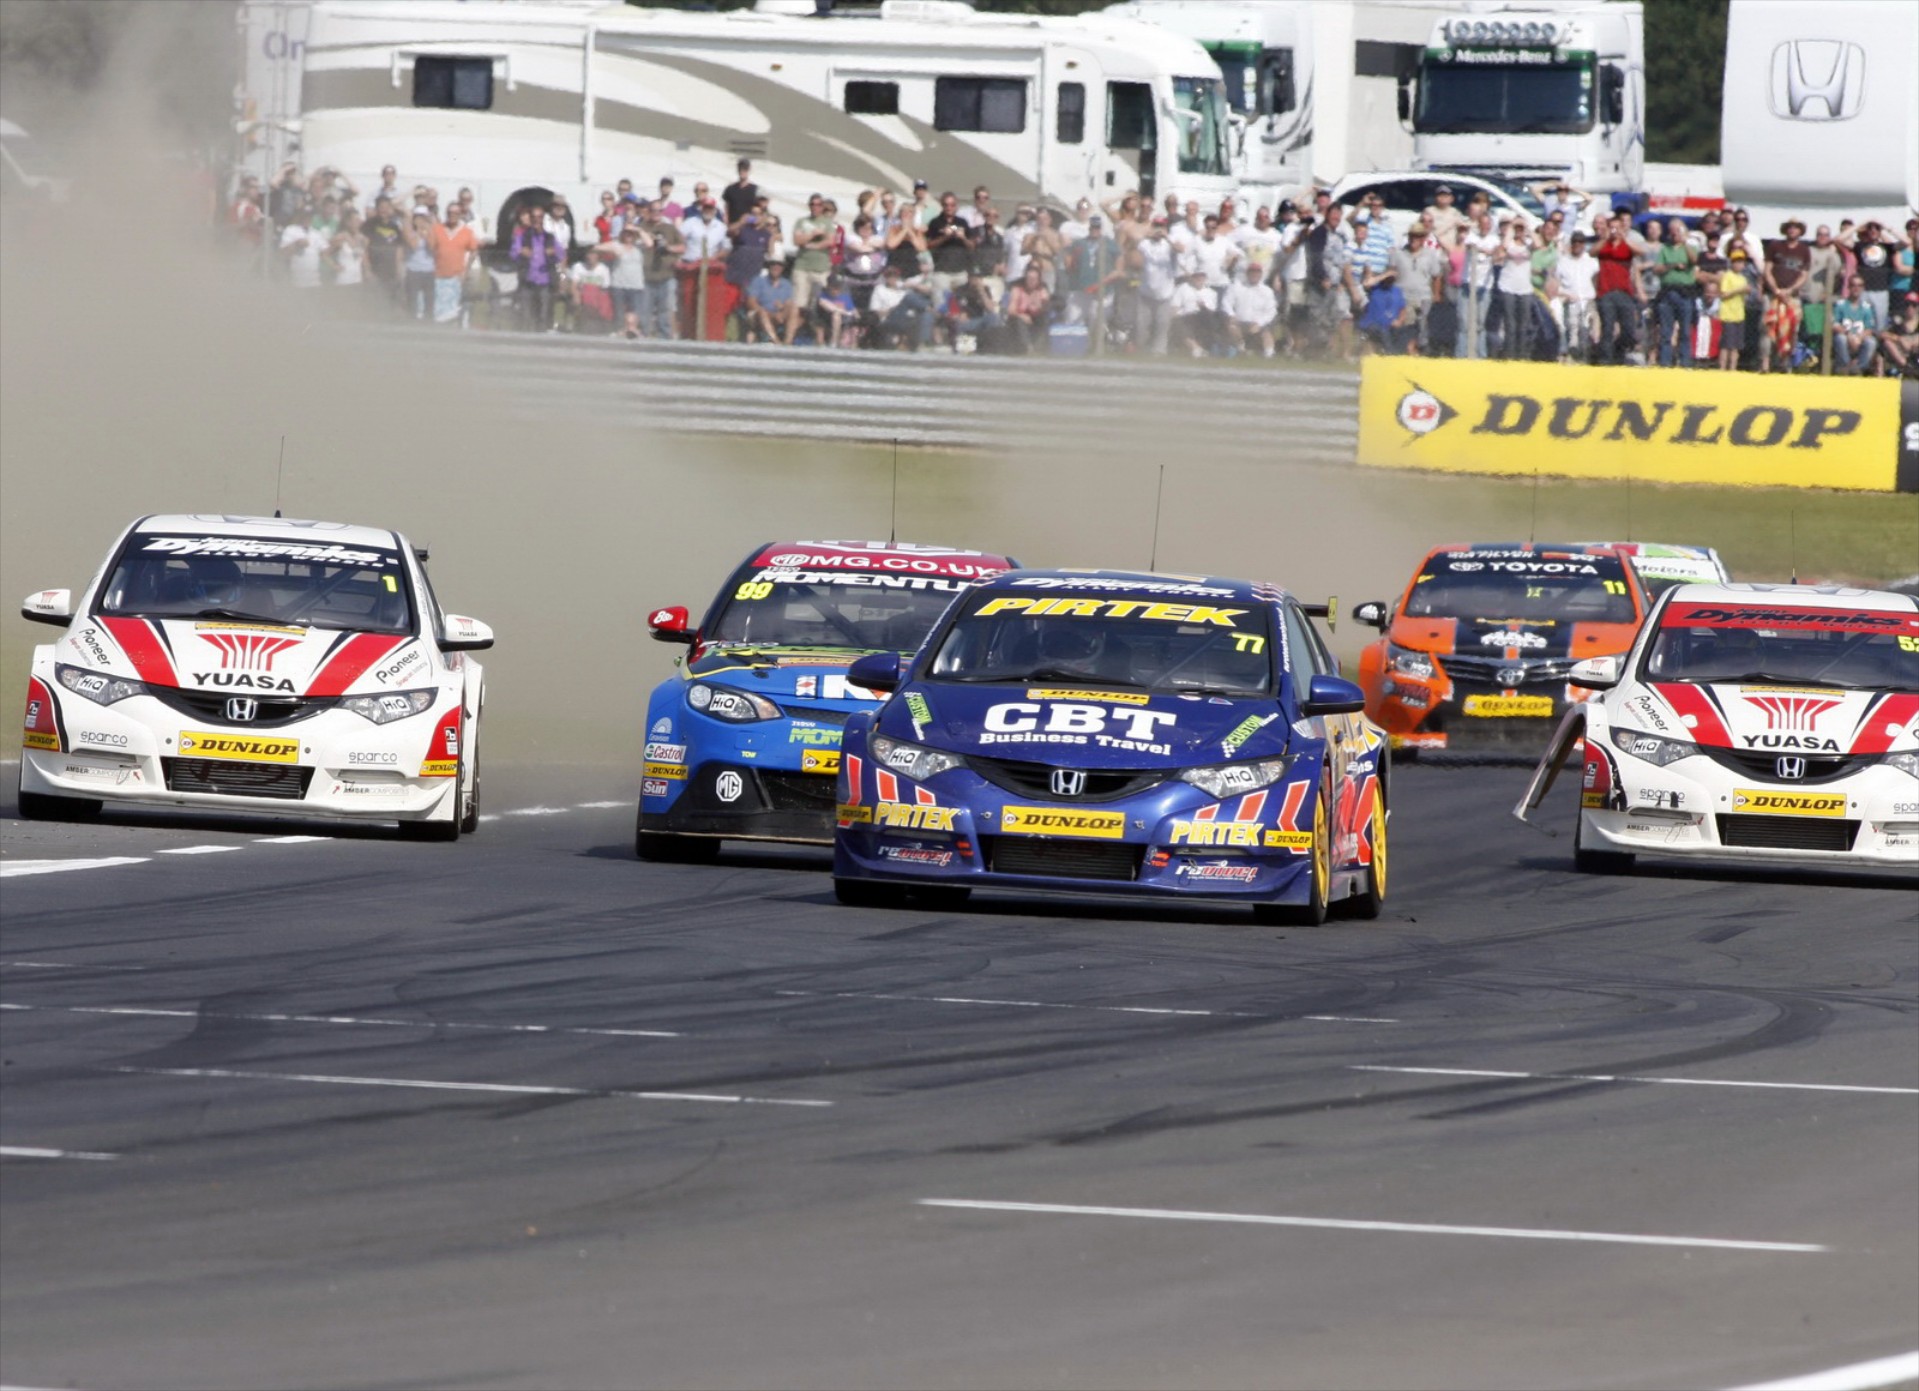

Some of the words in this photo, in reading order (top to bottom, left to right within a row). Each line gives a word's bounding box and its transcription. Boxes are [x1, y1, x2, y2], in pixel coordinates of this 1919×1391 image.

[1455, 49, 1551, 64] Mercedes-Benz
[1469, 392, 1862, 449] DUNLOP
[142, 537, 381, 562] Dynamics
[1489, 561, 1598, 575] TOYOTA
[382, 574, 397, 593] 1
[750, 570, 974, 592] MOMENTU
[1010, 577, 1236, 595] Dynamics
[1602, 580, 1626, 595] 11
[735, 582, 774, 600] 99
[974, 598, 1249, 627] PIRTEK
[1684, 608, 1903, 626] Dynamics
[79, 628, 111, 666] Pioneer
[1230, 632, 1264, 654] 77
[376, 650, 420, 684] Pioneer
[80, 678, 104, 691] HiQ
[192, 672, 297, 693] YUASA
[712, 697, 735, 709] HiQ
[1050, 690, 1148, 701] DUNLOP
[382, 698, 407, 711] HiQ
[1634, 695, 1669, 732] Pioneer
[984, 703, 1177, 741] CBT
[80, 731, 128, 746] sparco
[979, 732, 1088, 745] Business
[1095, 734, 1172, 756] Travel
[1634, 741, 1658, 752] HiQ
[1742, 734, 1842, 752] YUASA
[199, 739, 298, 756] DUNLOP
[654, 745, 684, 760] Castrol
[741, 750, 757, 758] TOW
[348, 751, 398, 763] sparco
[890, 751, 916, 763] HiQ
[652, 766, 687, 776] DUNLOP
[1224, 769, 1253, 784] HiQ
[643, 781, 667, 795] Sun
[718, 773, 741, 799] MG
[1640, 788, 1685, 803] sparo
[1751, 794, 1846, 811] DUNLOP
[873, 802, 961, 831] PIRTEK
[1893, 803, 1919, 815] spa
[1022, 814, 1122, 830] DUNLOP
[1626, 825, 1650, 833] AMBER
[1169, 821, 1264, 846] PIRTEK
[1276, 835, 1311, 844] DUNLOP
